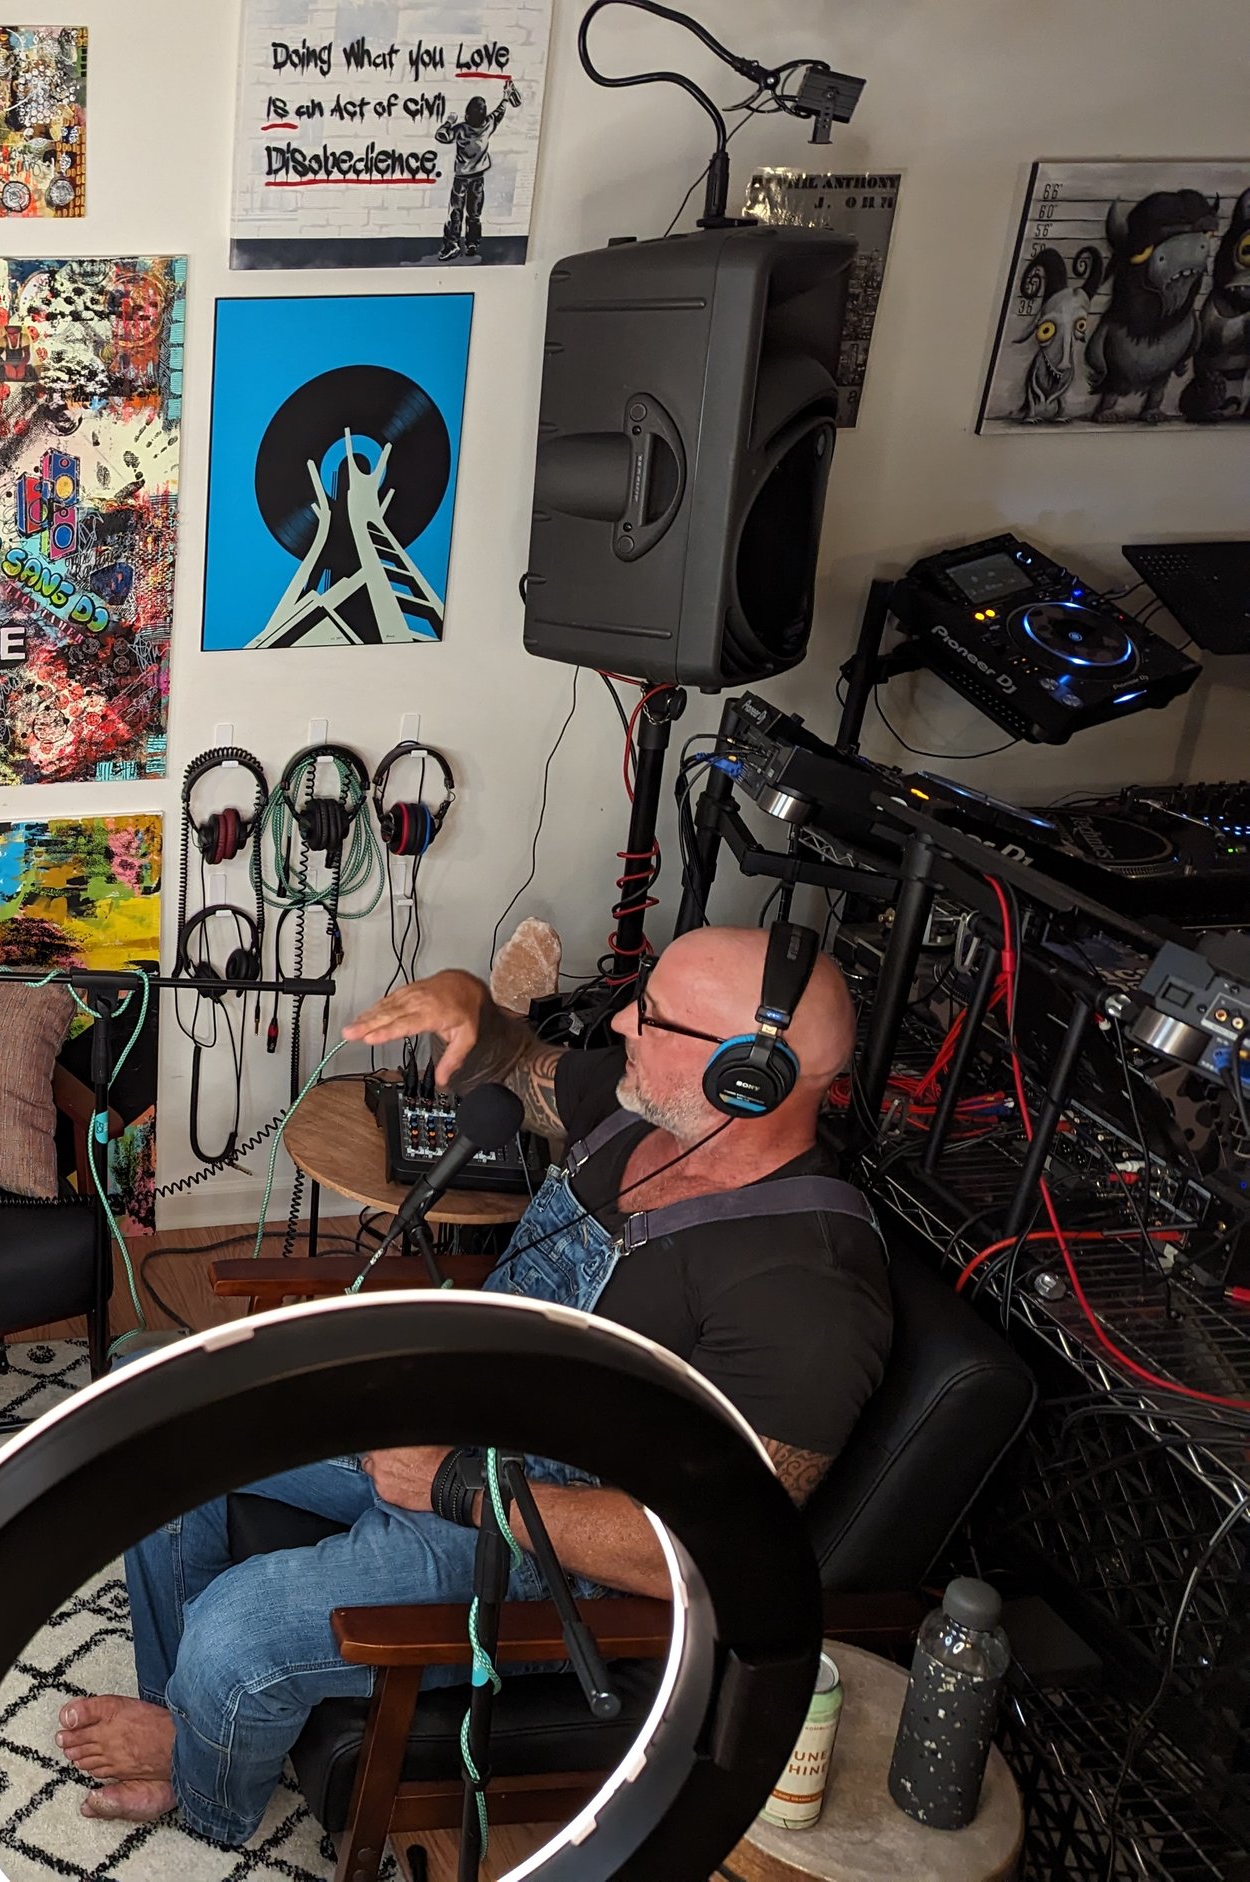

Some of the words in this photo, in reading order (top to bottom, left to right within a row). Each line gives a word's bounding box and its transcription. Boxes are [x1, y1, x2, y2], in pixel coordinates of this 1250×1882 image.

[271, 38, 333, 79] Doing
[343, 36, 400, 72] What
[409, 40, 444, 81] you
[456, 41, 510, 71] Love
[295, 98, 324, 120] an
[330, 94, 370, 122] Act
[373, 93, 400, 118] of
[822, 175, 897, 190] ANTHONY
[1, 548, 76, 609] SANG
[931, 625, 997, 676] Pioneer
[736, 1080, 761, 1091] SONY
[794, 1750, 828, 1761] UNE
